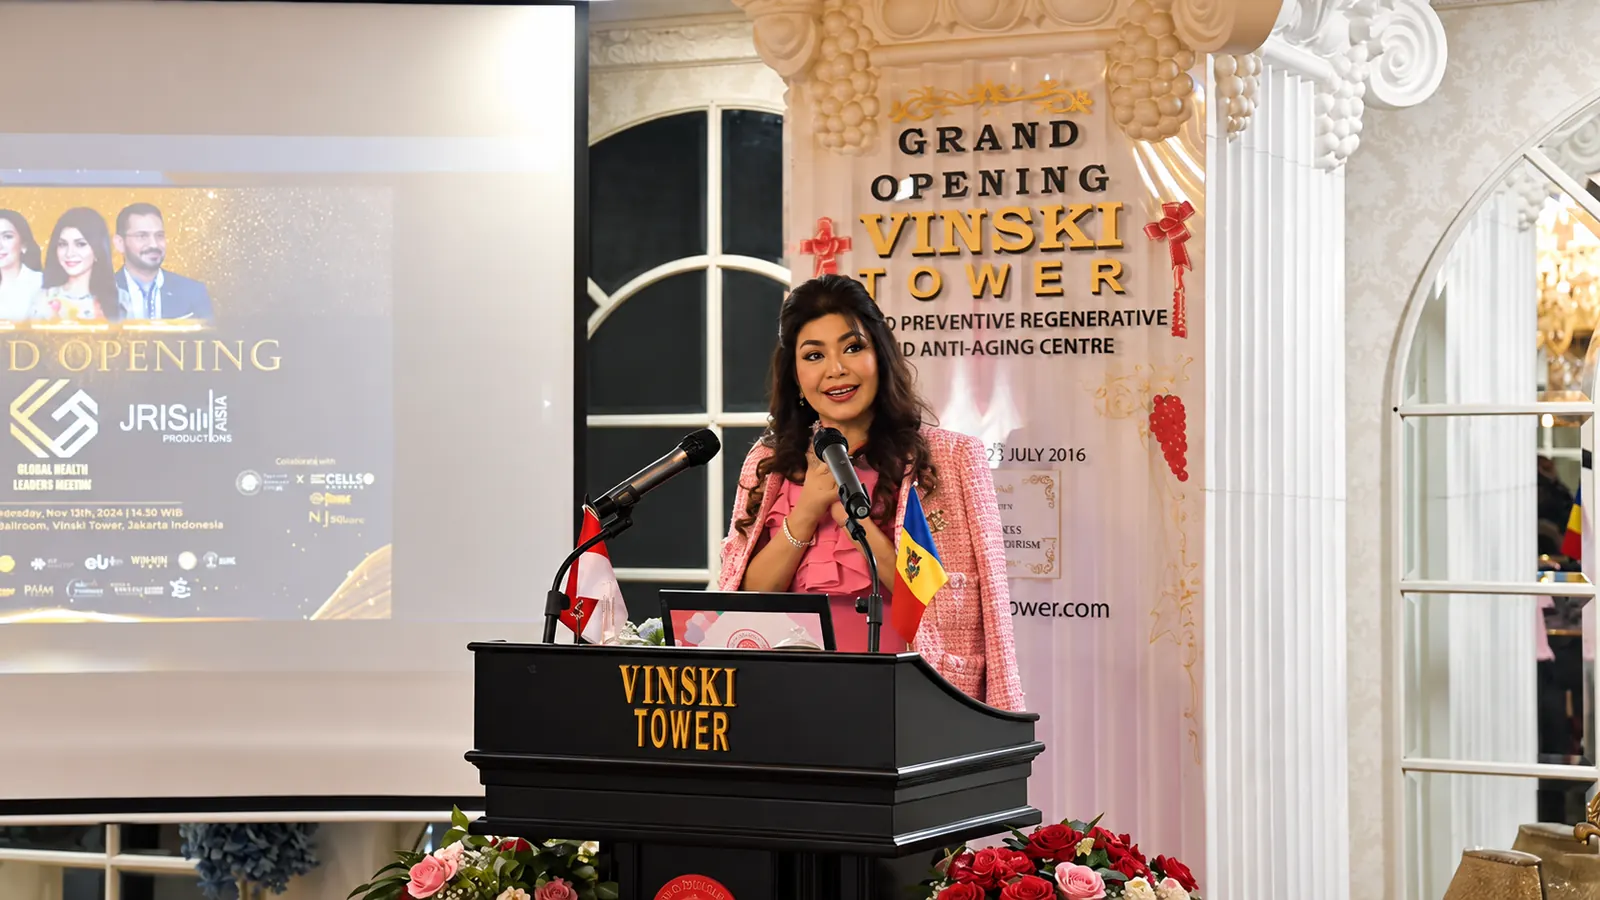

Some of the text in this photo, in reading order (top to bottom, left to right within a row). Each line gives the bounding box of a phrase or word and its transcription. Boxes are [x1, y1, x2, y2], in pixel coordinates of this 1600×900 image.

[898, 120, 1079, 155] GRAND
[870, 164, 1110, 202] OPENING
[859, 201, 1124, 258] VINSKI
[858, 258, 1126, 301] TOWER
[901, 313, 1015, 331] PREVENTIVE
[1020, 309, 1168, 328] REGENERATIVE
[7, 339, 282, 371] D OPENING
[920, 339, 1035, 357] ANTI-AGING
[1040, 338, 1115, 355] CENTRE
[119, 403, 189, 431] JRIS
[162, 433, 233, 443] PRODUCTIONS
[1008, 448, 1045, 462] JULY
[1048, 448, 1086, 462] 2016
[17, 463, 89, 475] GLOBAL HEALTH
[325, 473, 363, 485] CELLS
[13, 479, 54, 491] LEADERS
[46, 509, 68, 518] Nov
[97, 508, 123, 518] 2024
[160, 508, 184, 517] WIB
[52, 520, 86, 530] Vinski
[89, 521, 125, 531] Tower,
[127, 520, 169, 530] Jakarta
[171, 520, 224, 530] Indonesia
[1009, 600, 1110, 619] ower.com
[619, 664, 739, 707] VINSKI
[634, 708, 730, 751] TOWER
